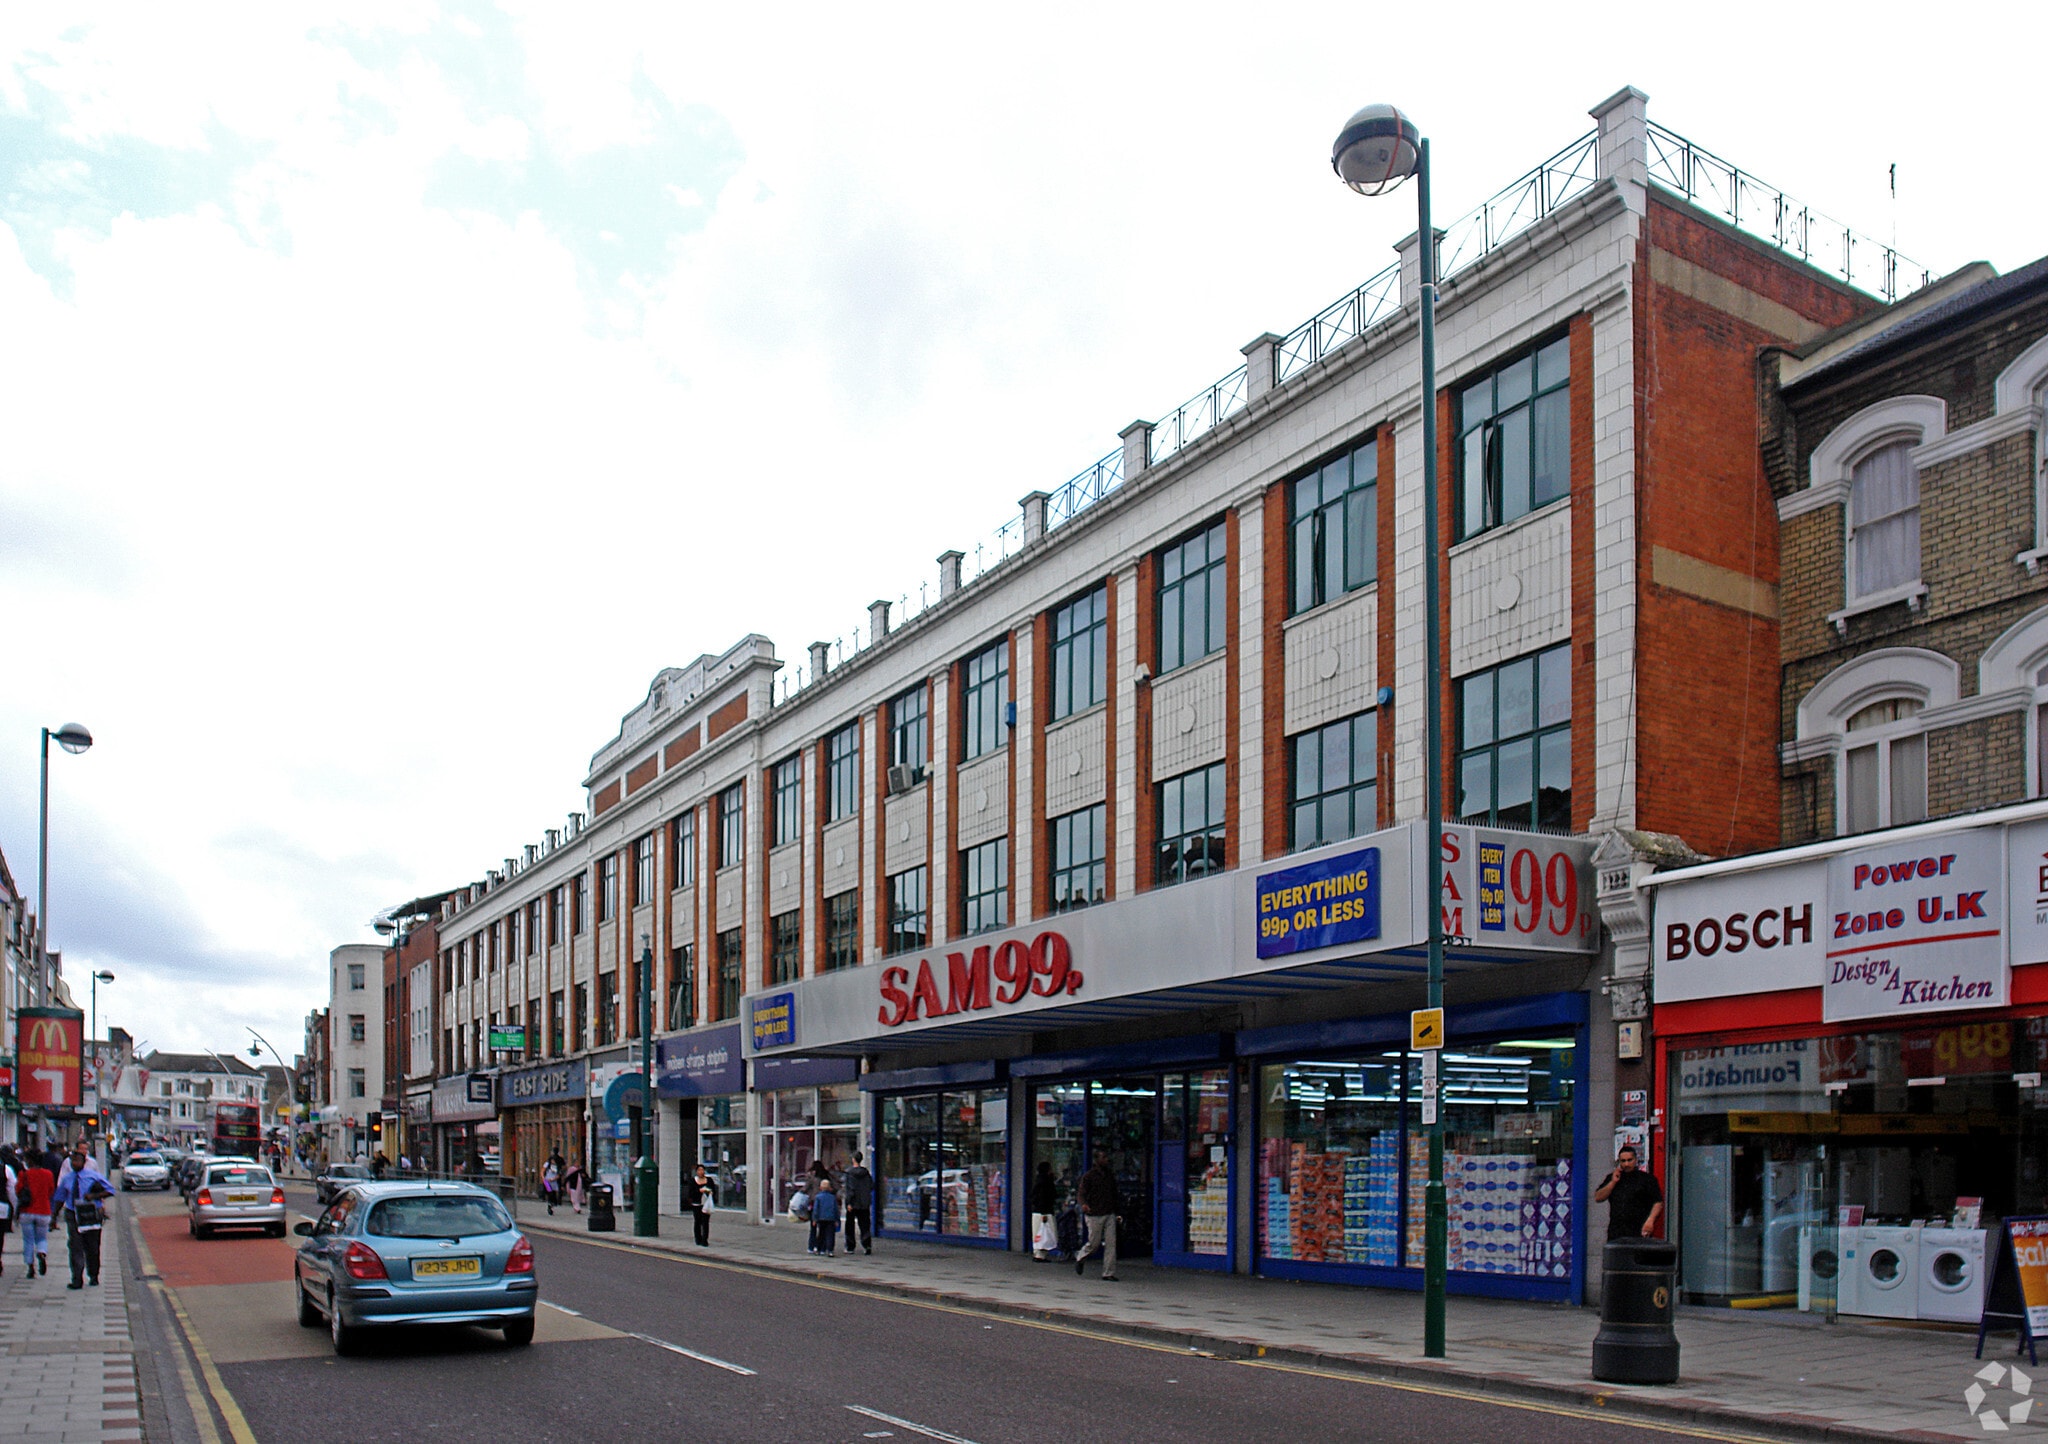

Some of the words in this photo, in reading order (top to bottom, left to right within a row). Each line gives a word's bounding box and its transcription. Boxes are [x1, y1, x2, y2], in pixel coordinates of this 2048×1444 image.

[1481, 848, 1504, 865] EVERY
[1484, 868, 1501, 885] ITEM
[1854, 854, 1957, 891] Power
[1260, 870, 1368, 913] EVERYTHING
[1493, 889, 1505, 905] OR
[1261, 916, 1290, 939] 99p
[1293, 908, 1317, 931] OR
[1321, 898, 1365, 925] LESS
[1484, 908, 1502, 924] LESS
[1834, 908, 1905, 939] Zone
[1918, 890, 1988, 924] U.K
[1666, 902, 1813, 962] BOSCH
[1831, 957, 1891, 985] Design
[1883, 966, 1901, 992] A
[1899, 975, 1994, 1005] Kitchen
[754, 1004, 789, 1023] EVERYTHING
[765, 1023, 773, 1035] OR
[773, 1020, 788, 1034] LESS
[513, 1076, 537, 1097] EAST
[541, 1071, 568, 1094] SIDE
[2015, 1240, 2048, 1267] sal
[416, 1261, 449, 1274] W235
